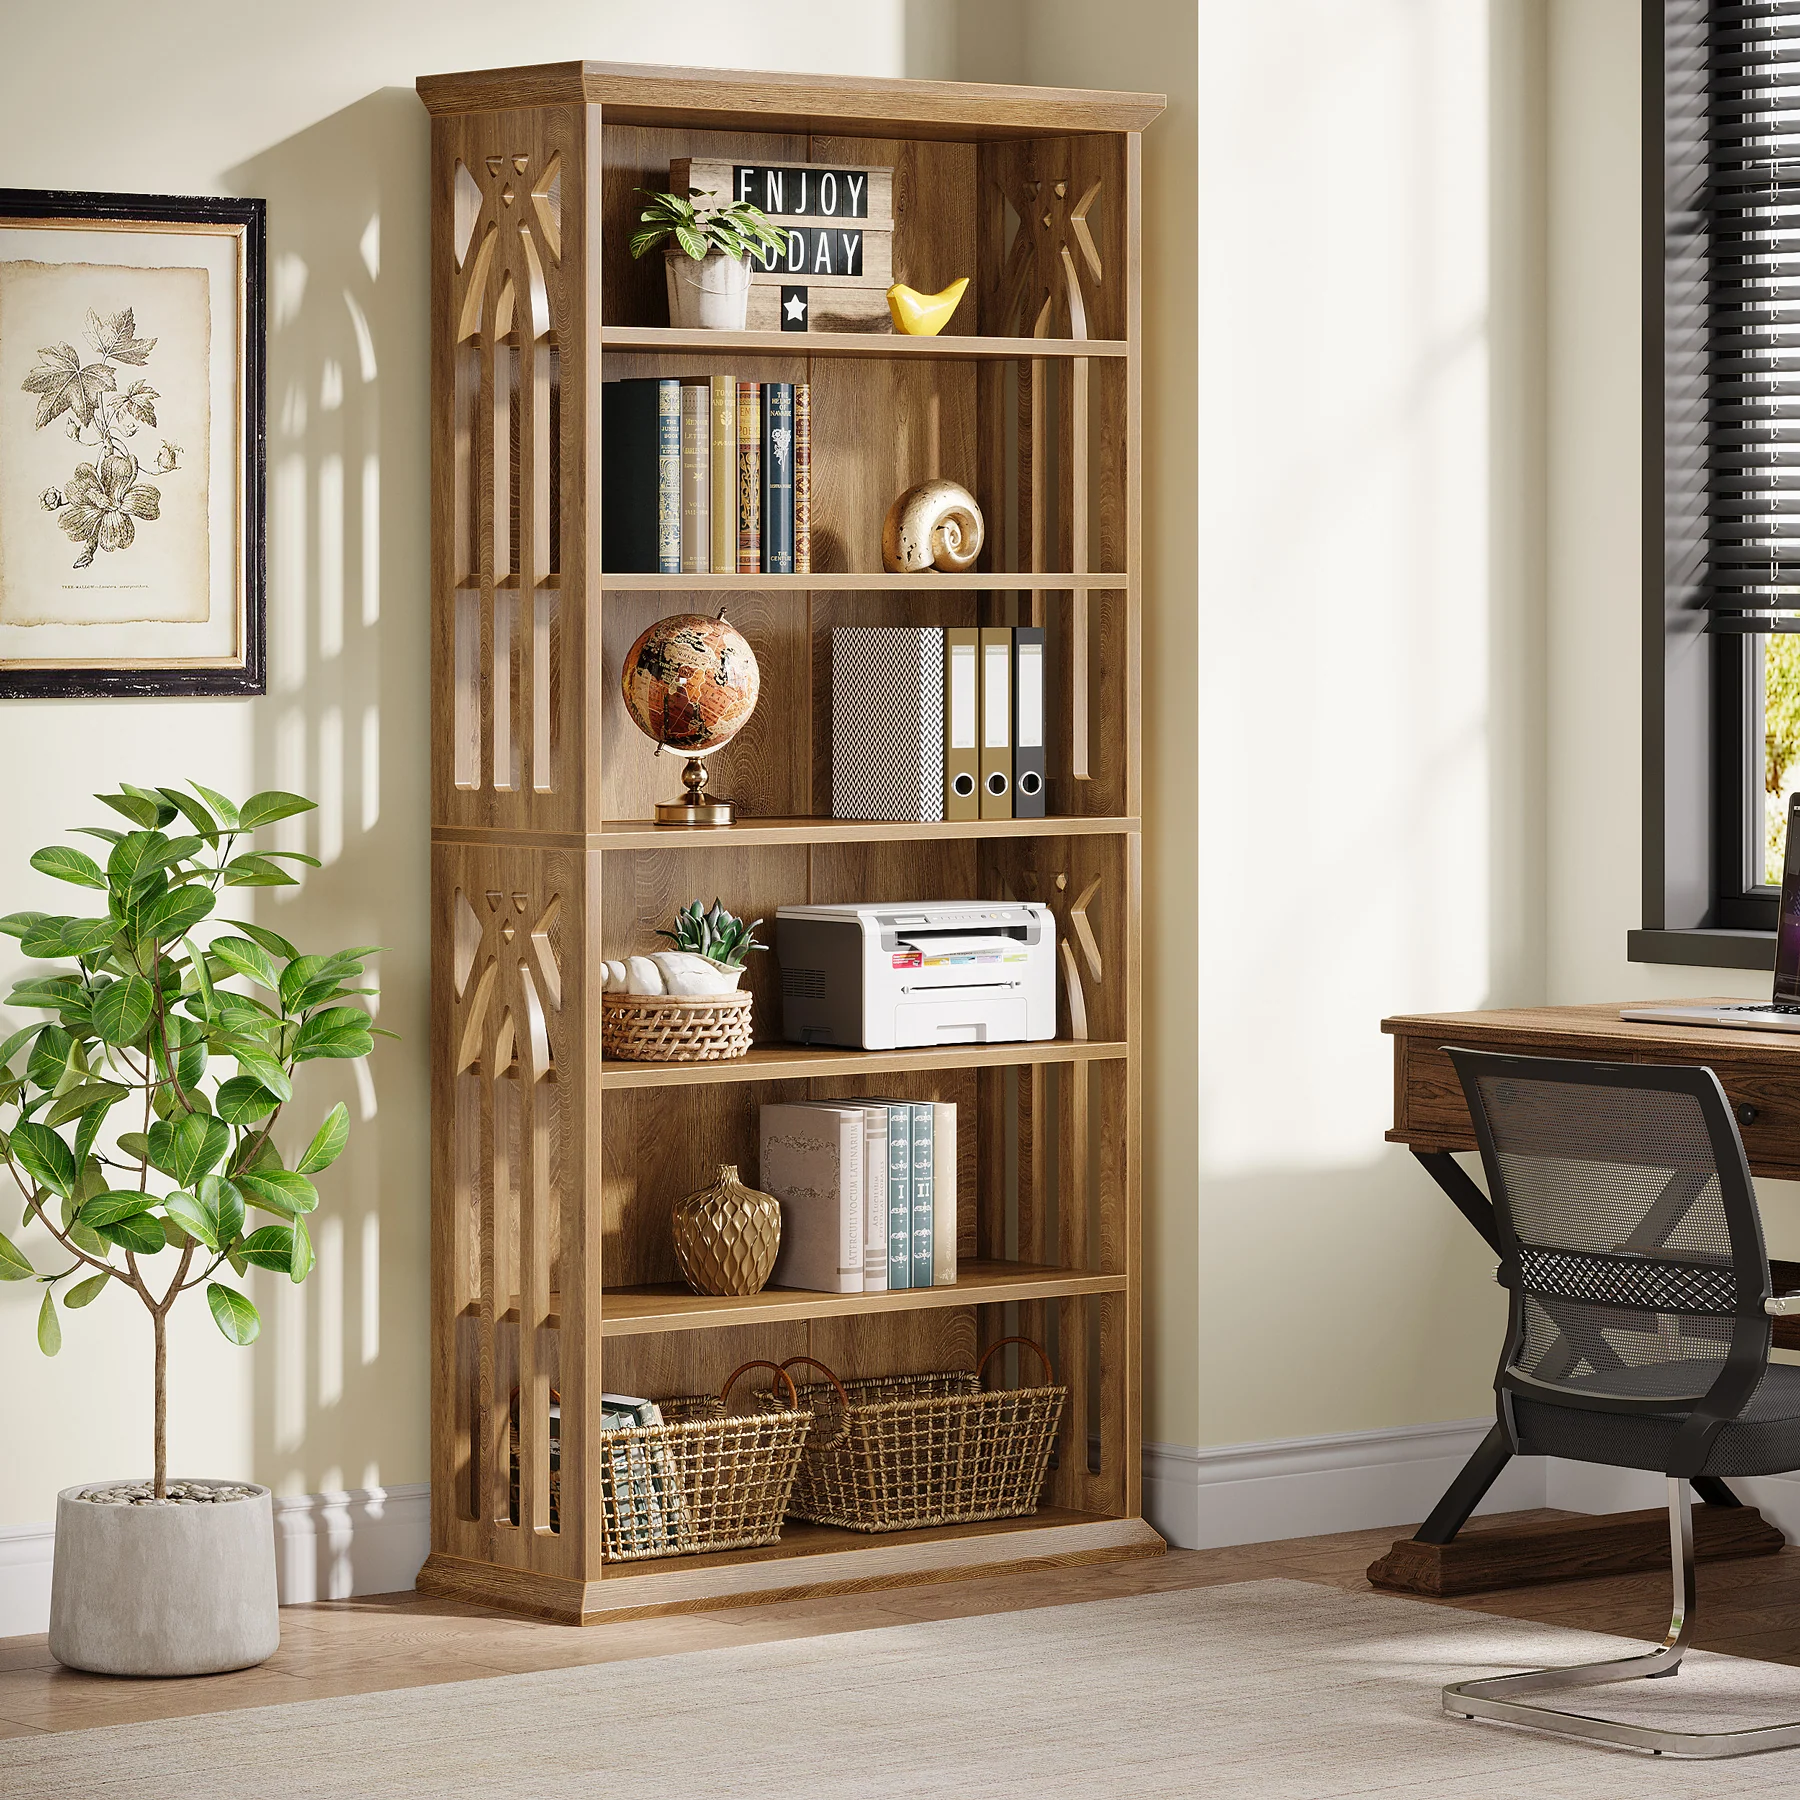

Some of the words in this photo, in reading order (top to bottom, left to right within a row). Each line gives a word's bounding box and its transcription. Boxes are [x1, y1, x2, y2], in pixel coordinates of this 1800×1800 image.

[741, 169, 863, 217] ENJOY
[850, 1124, 858, 1178] LATINARUM
[849, 1180, 858, 1215] VOCUM
[898, 1185, 904, 1199] I
[917, 1183, 930, 1197] II
[849, 1217, 858, 1266] LATERCULI
